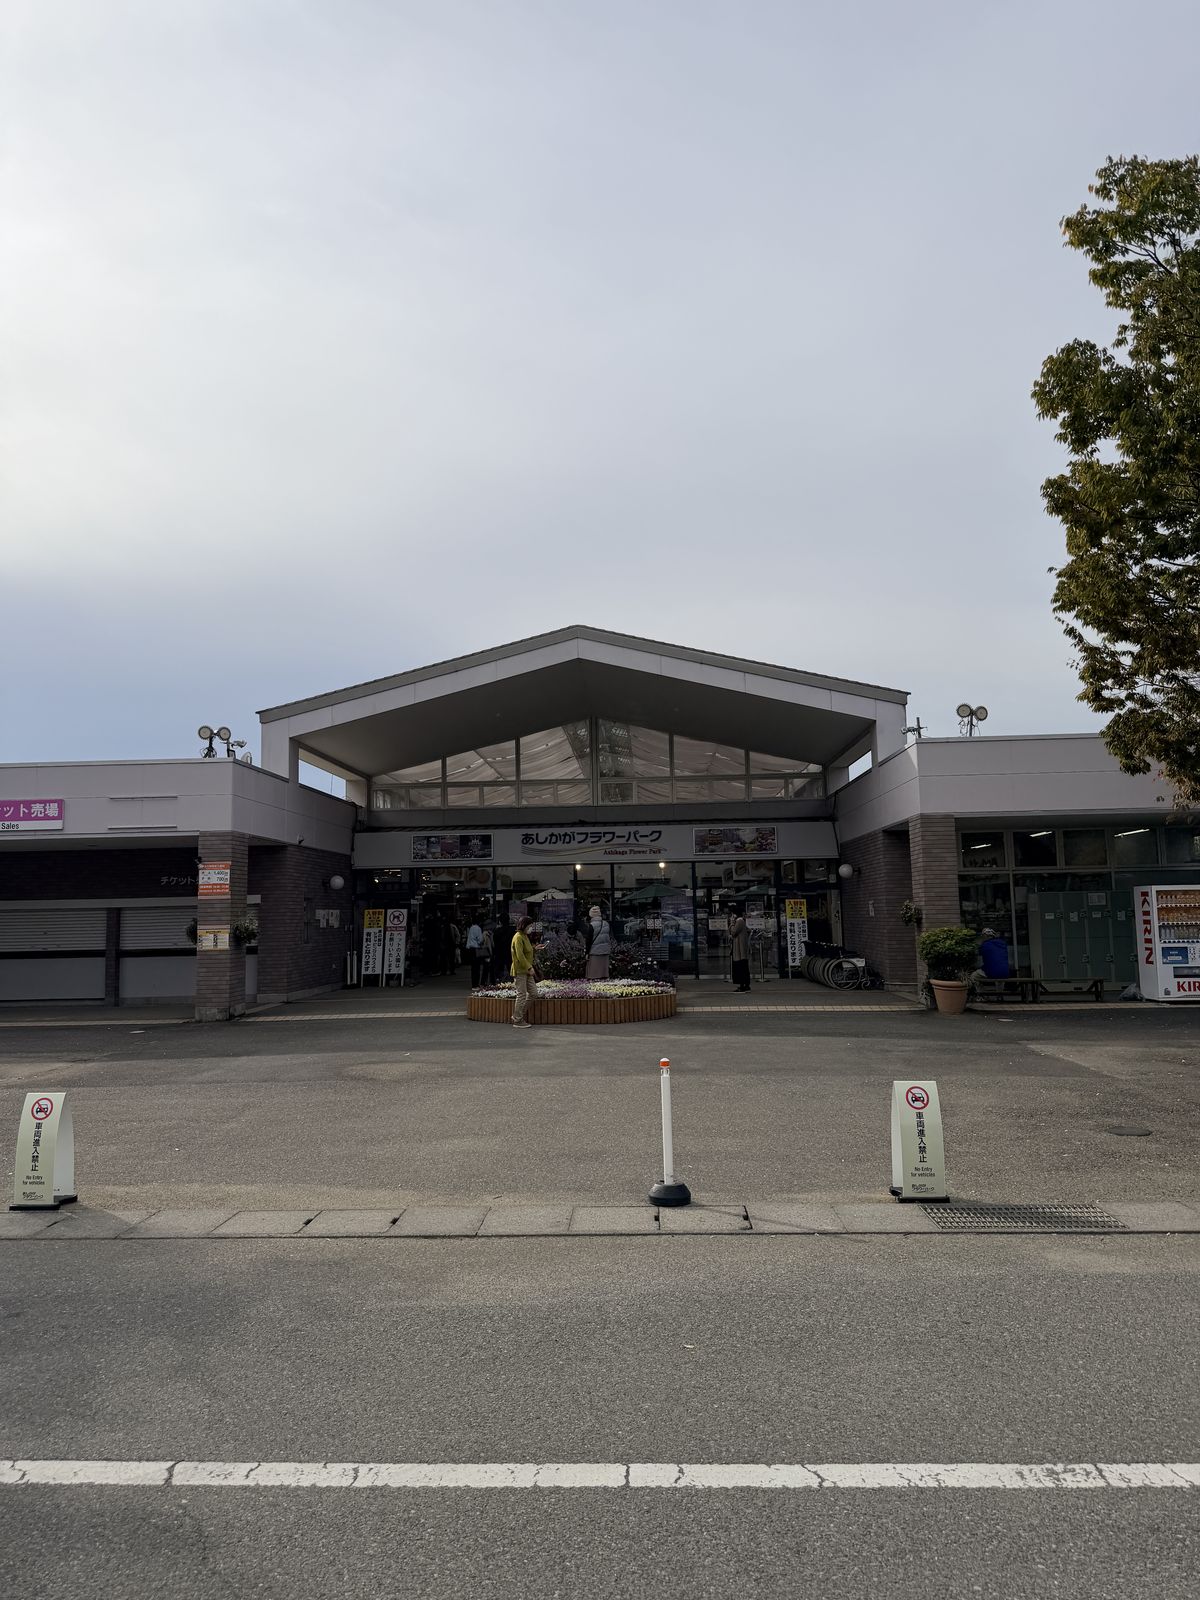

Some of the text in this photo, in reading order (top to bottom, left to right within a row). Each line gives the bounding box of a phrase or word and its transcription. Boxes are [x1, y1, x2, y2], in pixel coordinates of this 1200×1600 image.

[1, 822, 20, 830] Sales
[521, 829, 662, 845] あしかがフラワーパーク
[1140, 891, 1154, 965] KIRIN
[31, 1122, 43, 1172] 車両進入禁止
[915, 1111, 927, 1163] 車両進入禁止
